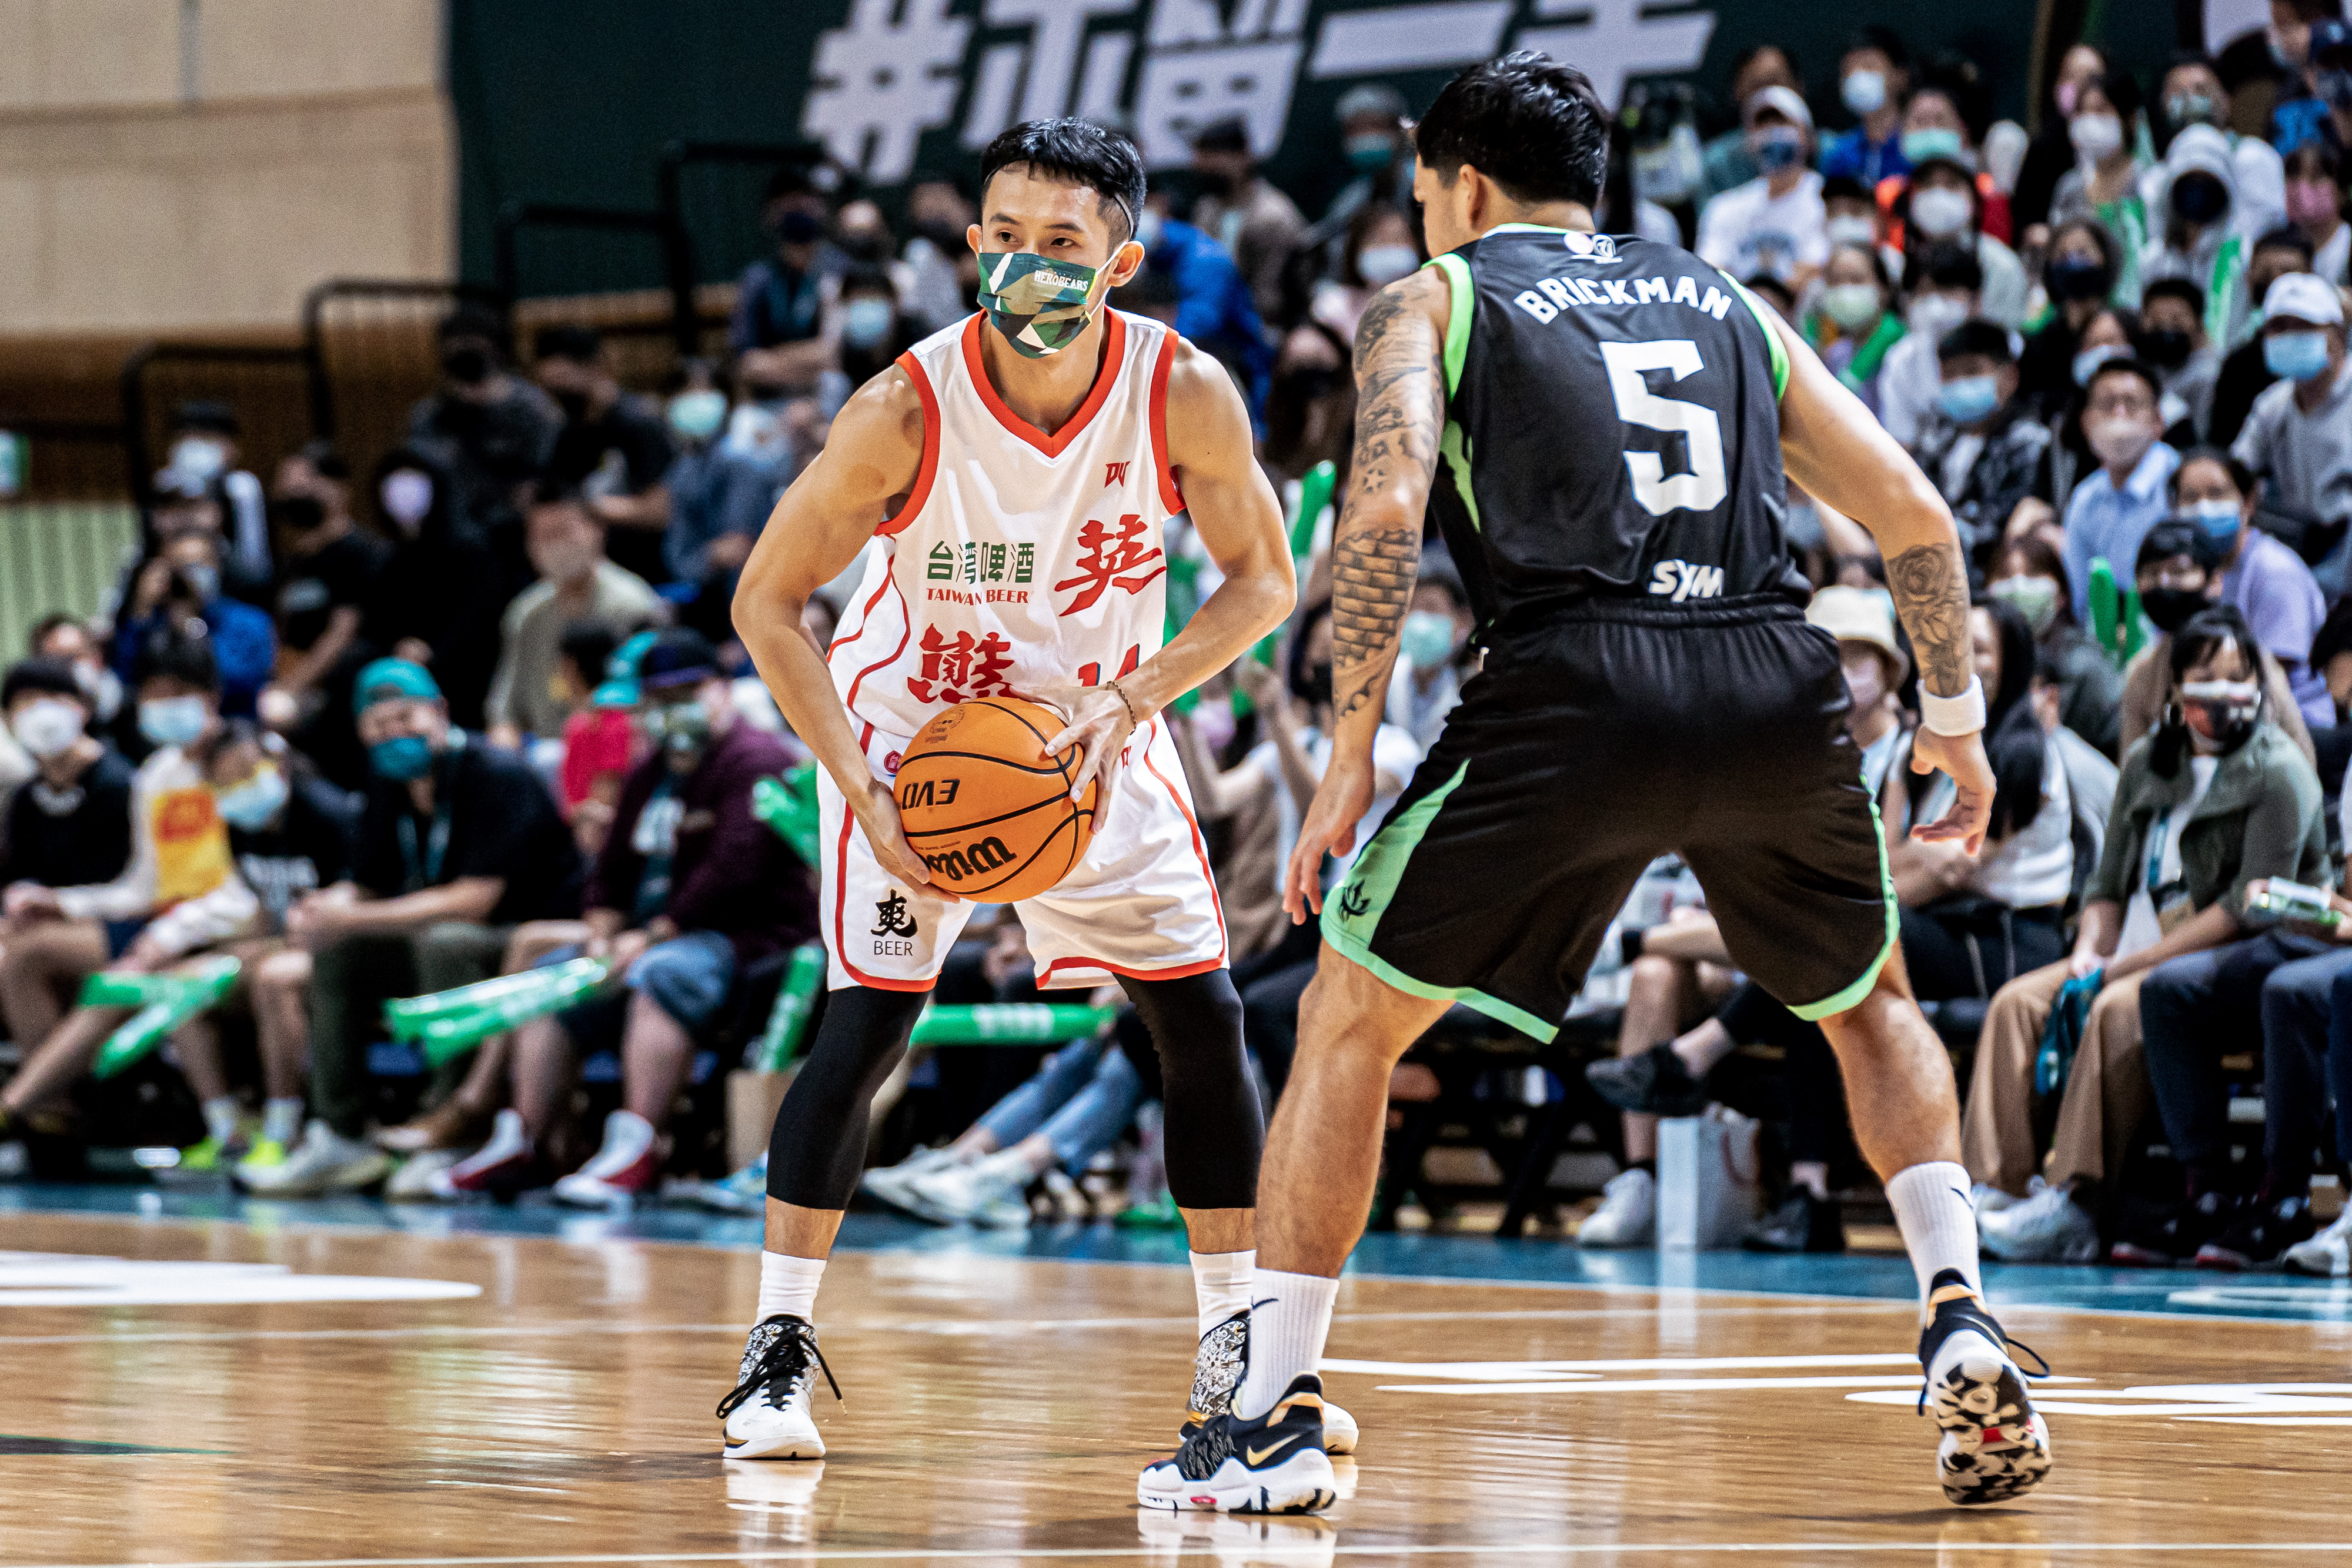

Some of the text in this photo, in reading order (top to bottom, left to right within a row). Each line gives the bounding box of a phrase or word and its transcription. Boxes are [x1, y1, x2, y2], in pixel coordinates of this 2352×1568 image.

[1034, 269, 1088, 292] HEROBEARS
[1514, 276, 1732, 325] BRICKMAN
[1598, 339, 1728, 516] 5
[1054, 514, 1167, 617] 英
[1649, 559, 1724, 603] SYM
[926, 588, 1029, 606] TAIWAN BEER
[907, 623, 1018, 704] 熊
[902, 778, 961, 811] EVO
[870, 888, 918, 938] 爽
[874, 940, 913, 957] BEER
